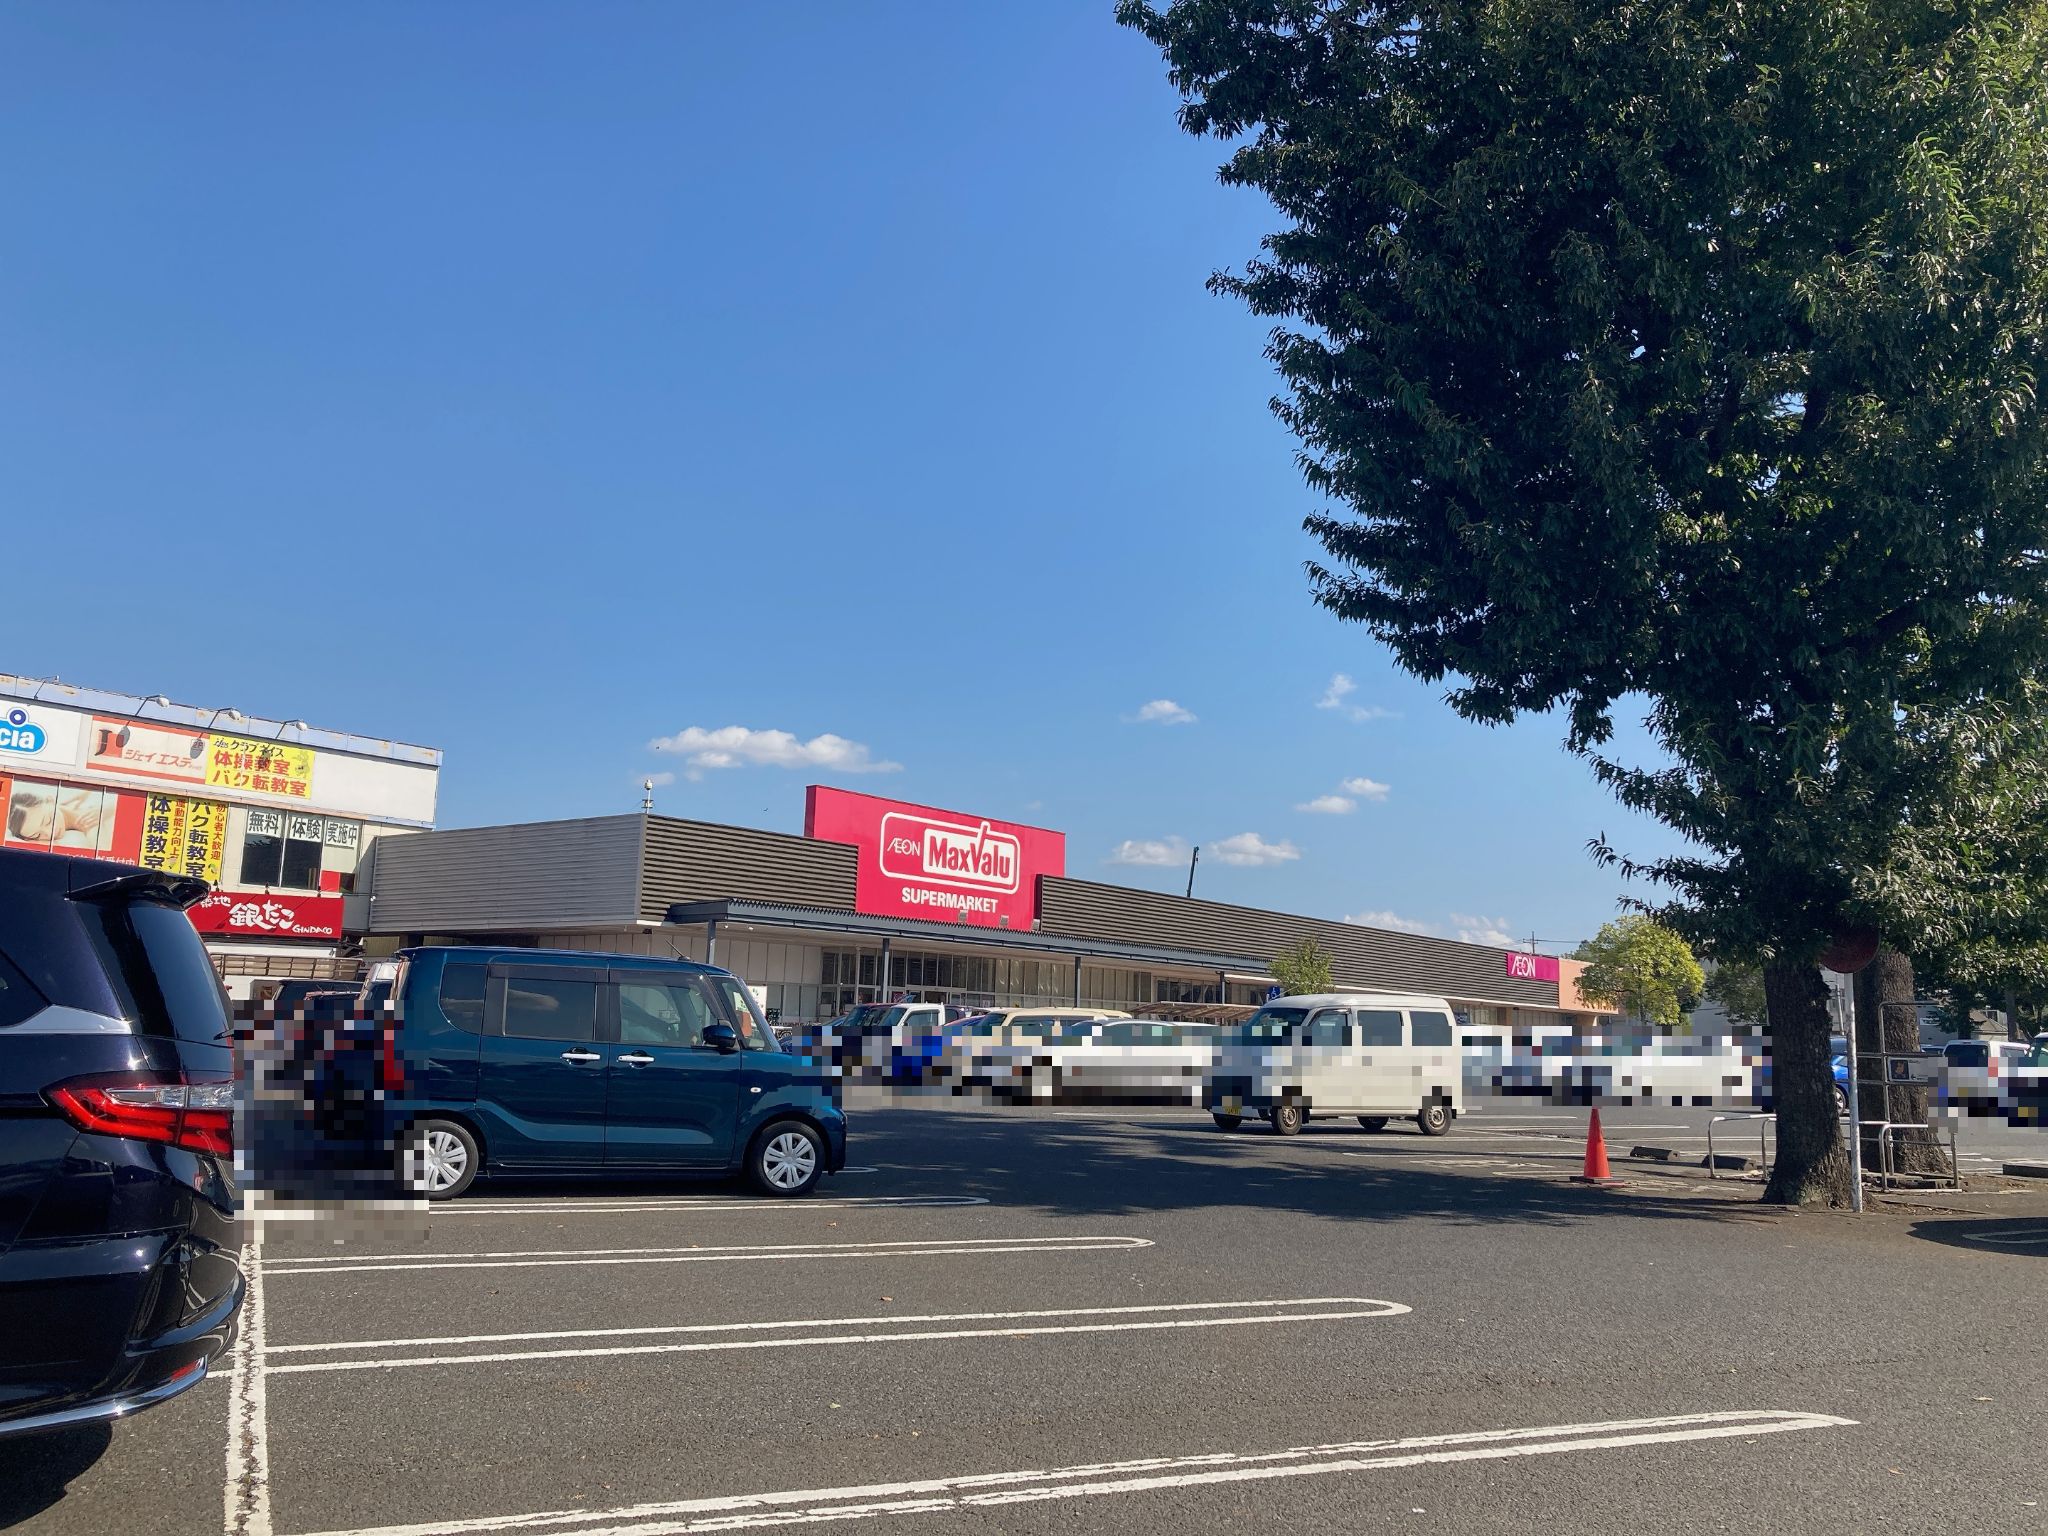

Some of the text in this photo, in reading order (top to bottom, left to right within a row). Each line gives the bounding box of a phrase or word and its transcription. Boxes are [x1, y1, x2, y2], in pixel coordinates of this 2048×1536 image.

[214, 750, 291, 777] 体操教室
[213, 769, 307, 797] バク転教室
[144, 795, 171, 869] 体操教室
[170, 798, 186, 857] 運動能力向上
[186, 802, 211, 878] バク転教室
[211, 803, 226, 861] 初心者大歓迎
[249, 812, 358, 846] 無料 体験 実施中
[928, 825, 1010, 878] MaxValu
[229, 899, 295, 930] 銀だこ
[901, 887, 999, 913] SUPERMARKET
[292, 924, 333, 934] GINDACO
